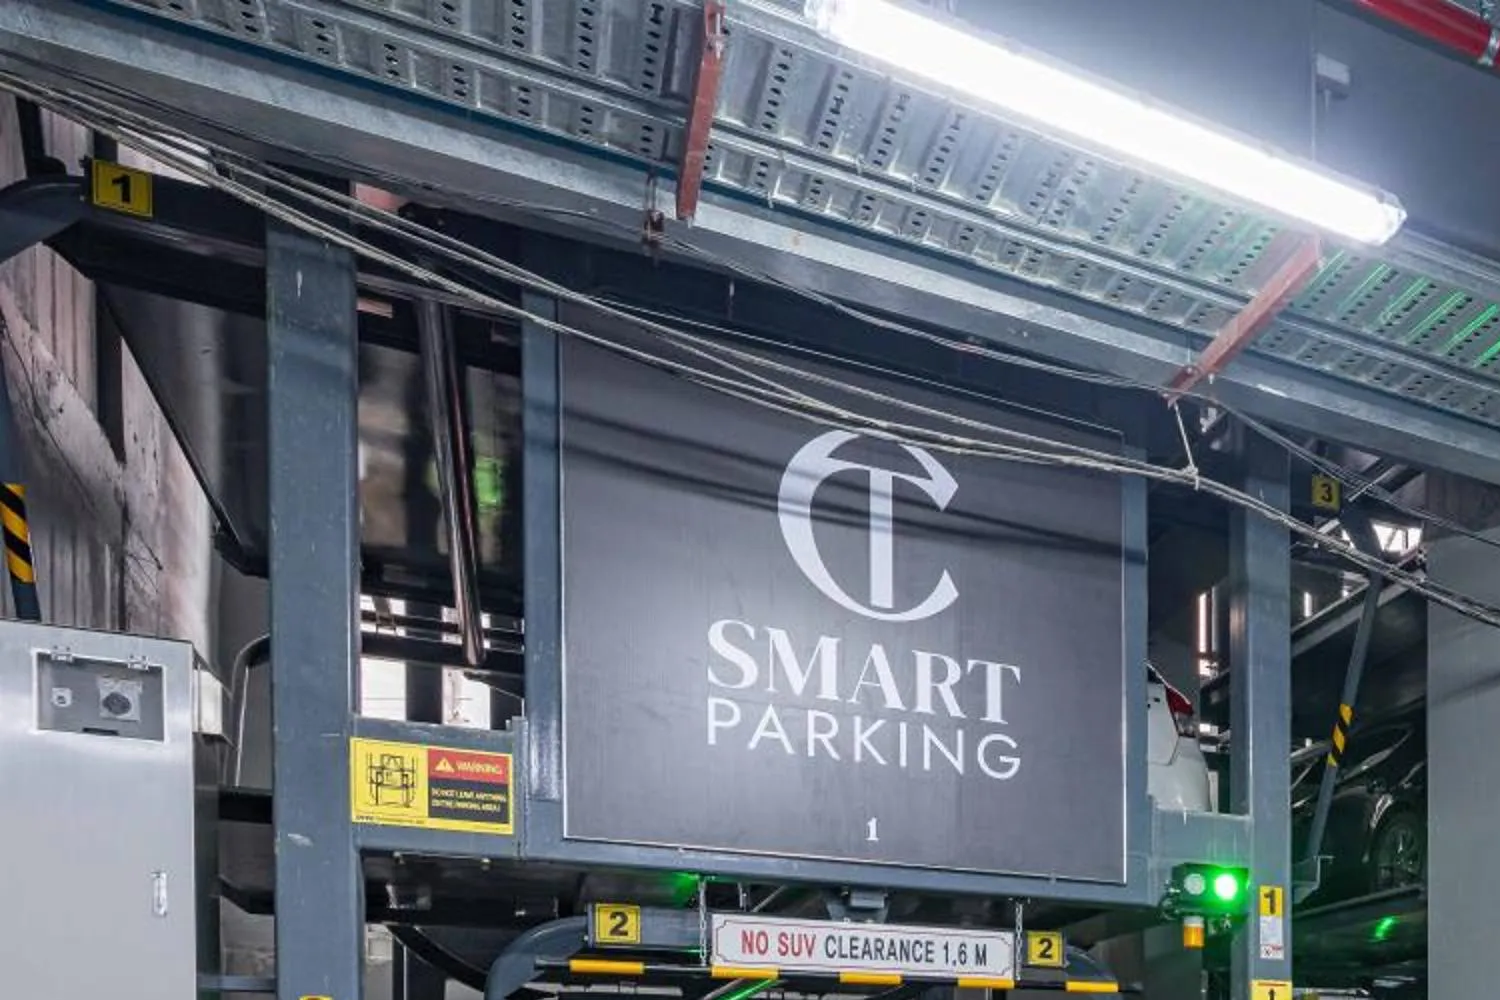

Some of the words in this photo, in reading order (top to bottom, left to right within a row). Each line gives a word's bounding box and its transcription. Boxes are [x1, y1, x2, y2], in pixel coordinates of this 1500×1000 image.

[112, 174, 130, 204] 1
[1321, 483, 1333, 503] 3
[707, 618, 1021, 725] SMART
[707, 698, 1021, 780] PARKING
[866, 817, 879, 841] 1
[1264, 889, 1276, 915] 1
[609, 911, 628, 936] 2
[741, 929, 769, 955] NO
[777, 931, 817, 958] SUV
[824, 935, 934, 964] CLEARANCE
[943, 942, 968, 967] 1.6
[975, 943, 988, 967] M
[1039, 937, 1053, 960] 2
